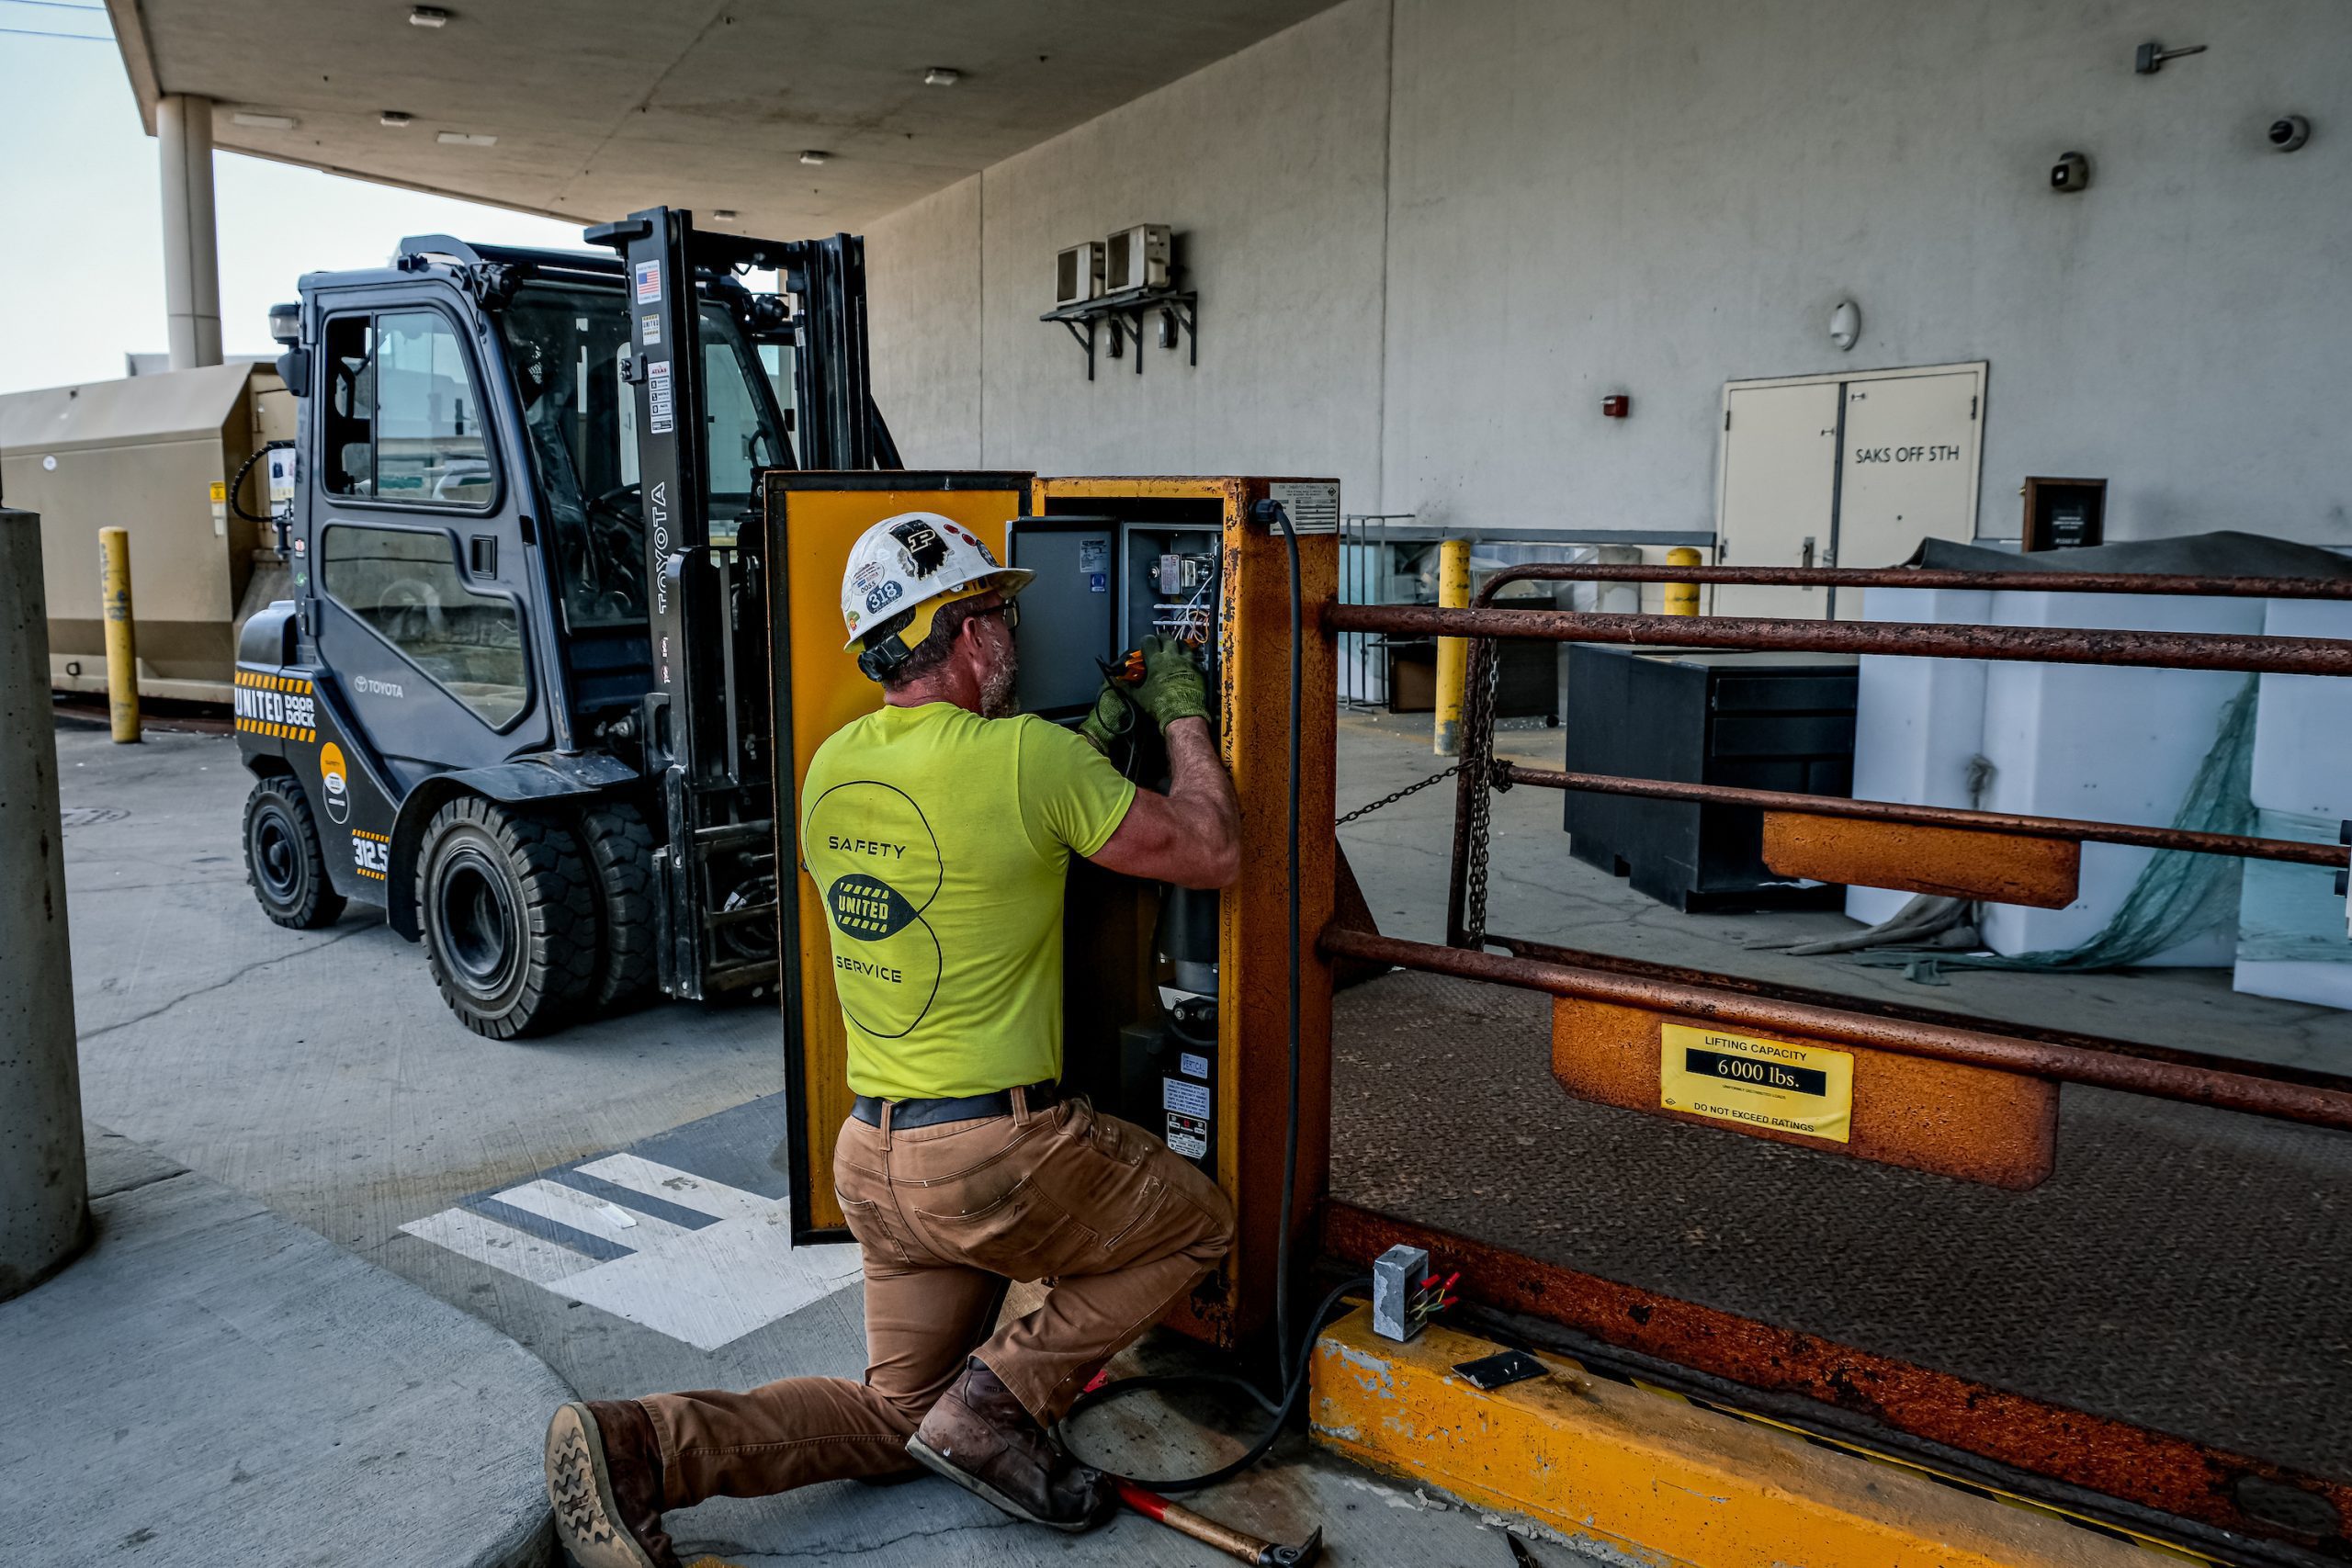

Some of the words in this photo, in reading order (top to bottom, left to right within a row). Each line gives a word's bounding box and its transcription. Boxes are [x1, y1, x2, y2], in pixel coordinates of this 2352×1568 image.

[1856, 447, 1891, 464] SAKS
[1895, 446, 1925, 462] OFF
[1928, 445, 1960, 462] 5TH
[868, 582, 898, 609] 318
[368, 679, 404, 698] TOYOTA
[235, 687, 284, 723] UNITED
[284, 694, 314, 713] DOOR
[285, 709, 317, 728] DOCK
[829, 836, 908, 862] SAFETY
[836, 895, 890, 922] UNITED
[835, 954, 903, 984] SERVICE
[1705, 1035, 1747, 1052] LIFTING
[1750, 1043, 1807, 1062] CAPACITY
[1182, 1060, 1205, 1071] VERTICAL
[1770, 1066, 1800, 1088] lbs.
[1694, 1102, 1707, 1112] DO
[1710, 1105, 1729, 1116] NOT
[1732, 1110, 1770, 1124] EXCEED
[1771, 1117, 1815, 1133] RATINGS
